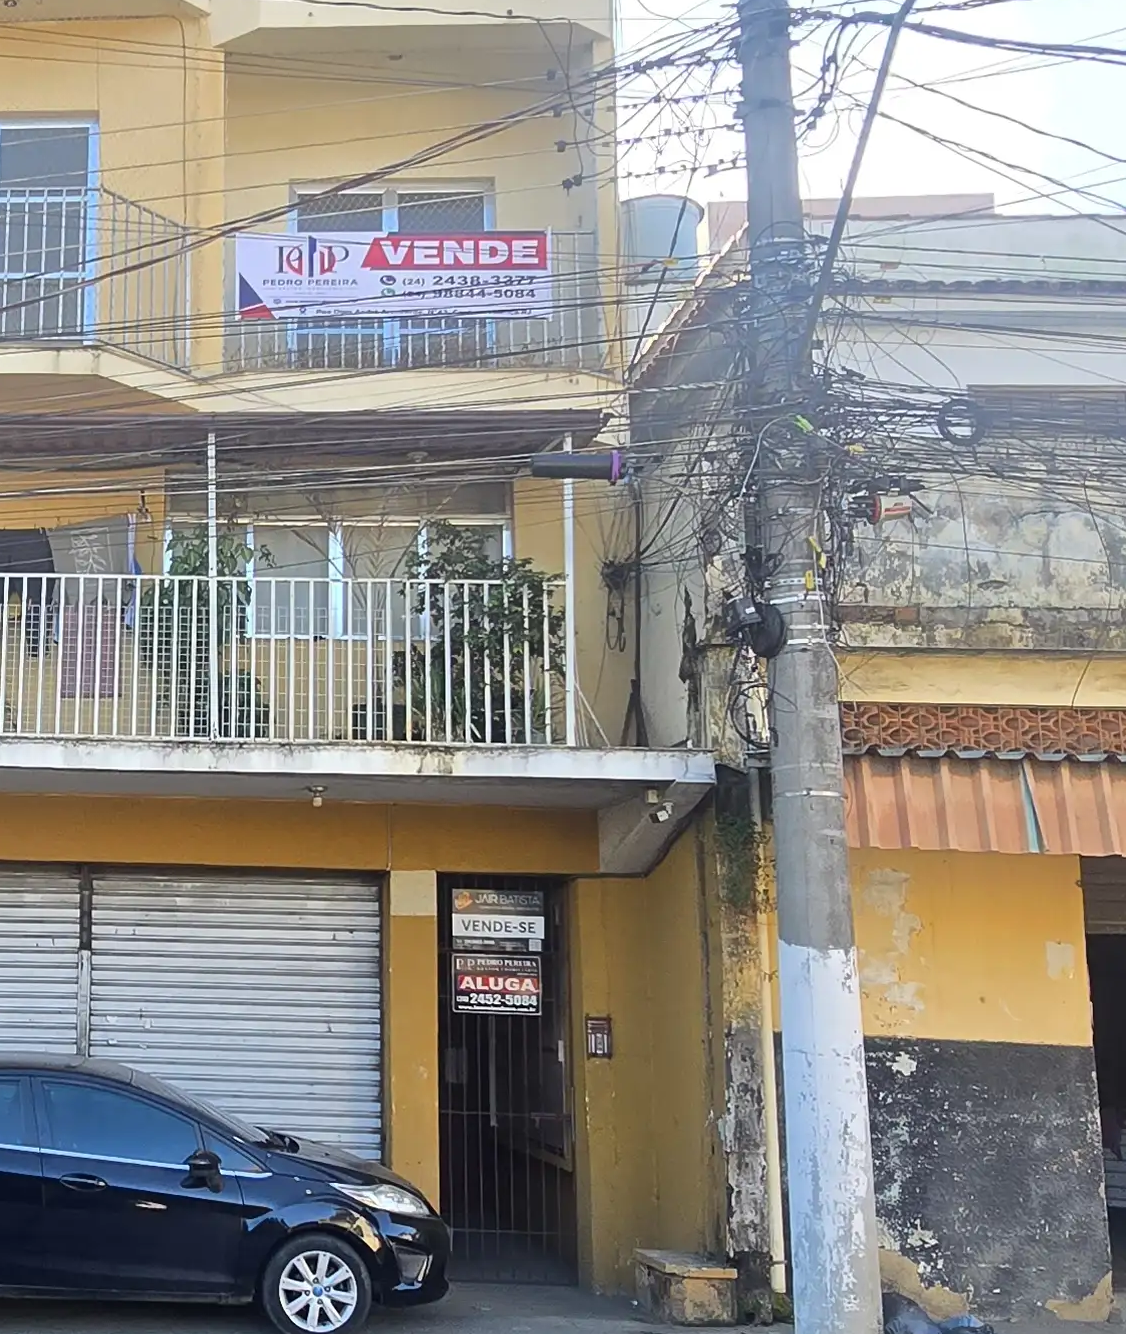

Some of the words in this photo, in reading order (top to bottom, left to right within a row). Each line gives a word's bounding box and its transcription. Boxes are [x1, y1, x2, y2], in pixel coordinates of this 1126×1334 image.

[379, 240, 539, 265] VENDE
[402, 278, 425, 287] (24)
[499, 894, 541, 905] BATISTA
[461, 919, 536, 934] VENDE-SE
[459, 976, 539, 992] ALUGA
[470, 993, 537, 1005] 2452-5084
